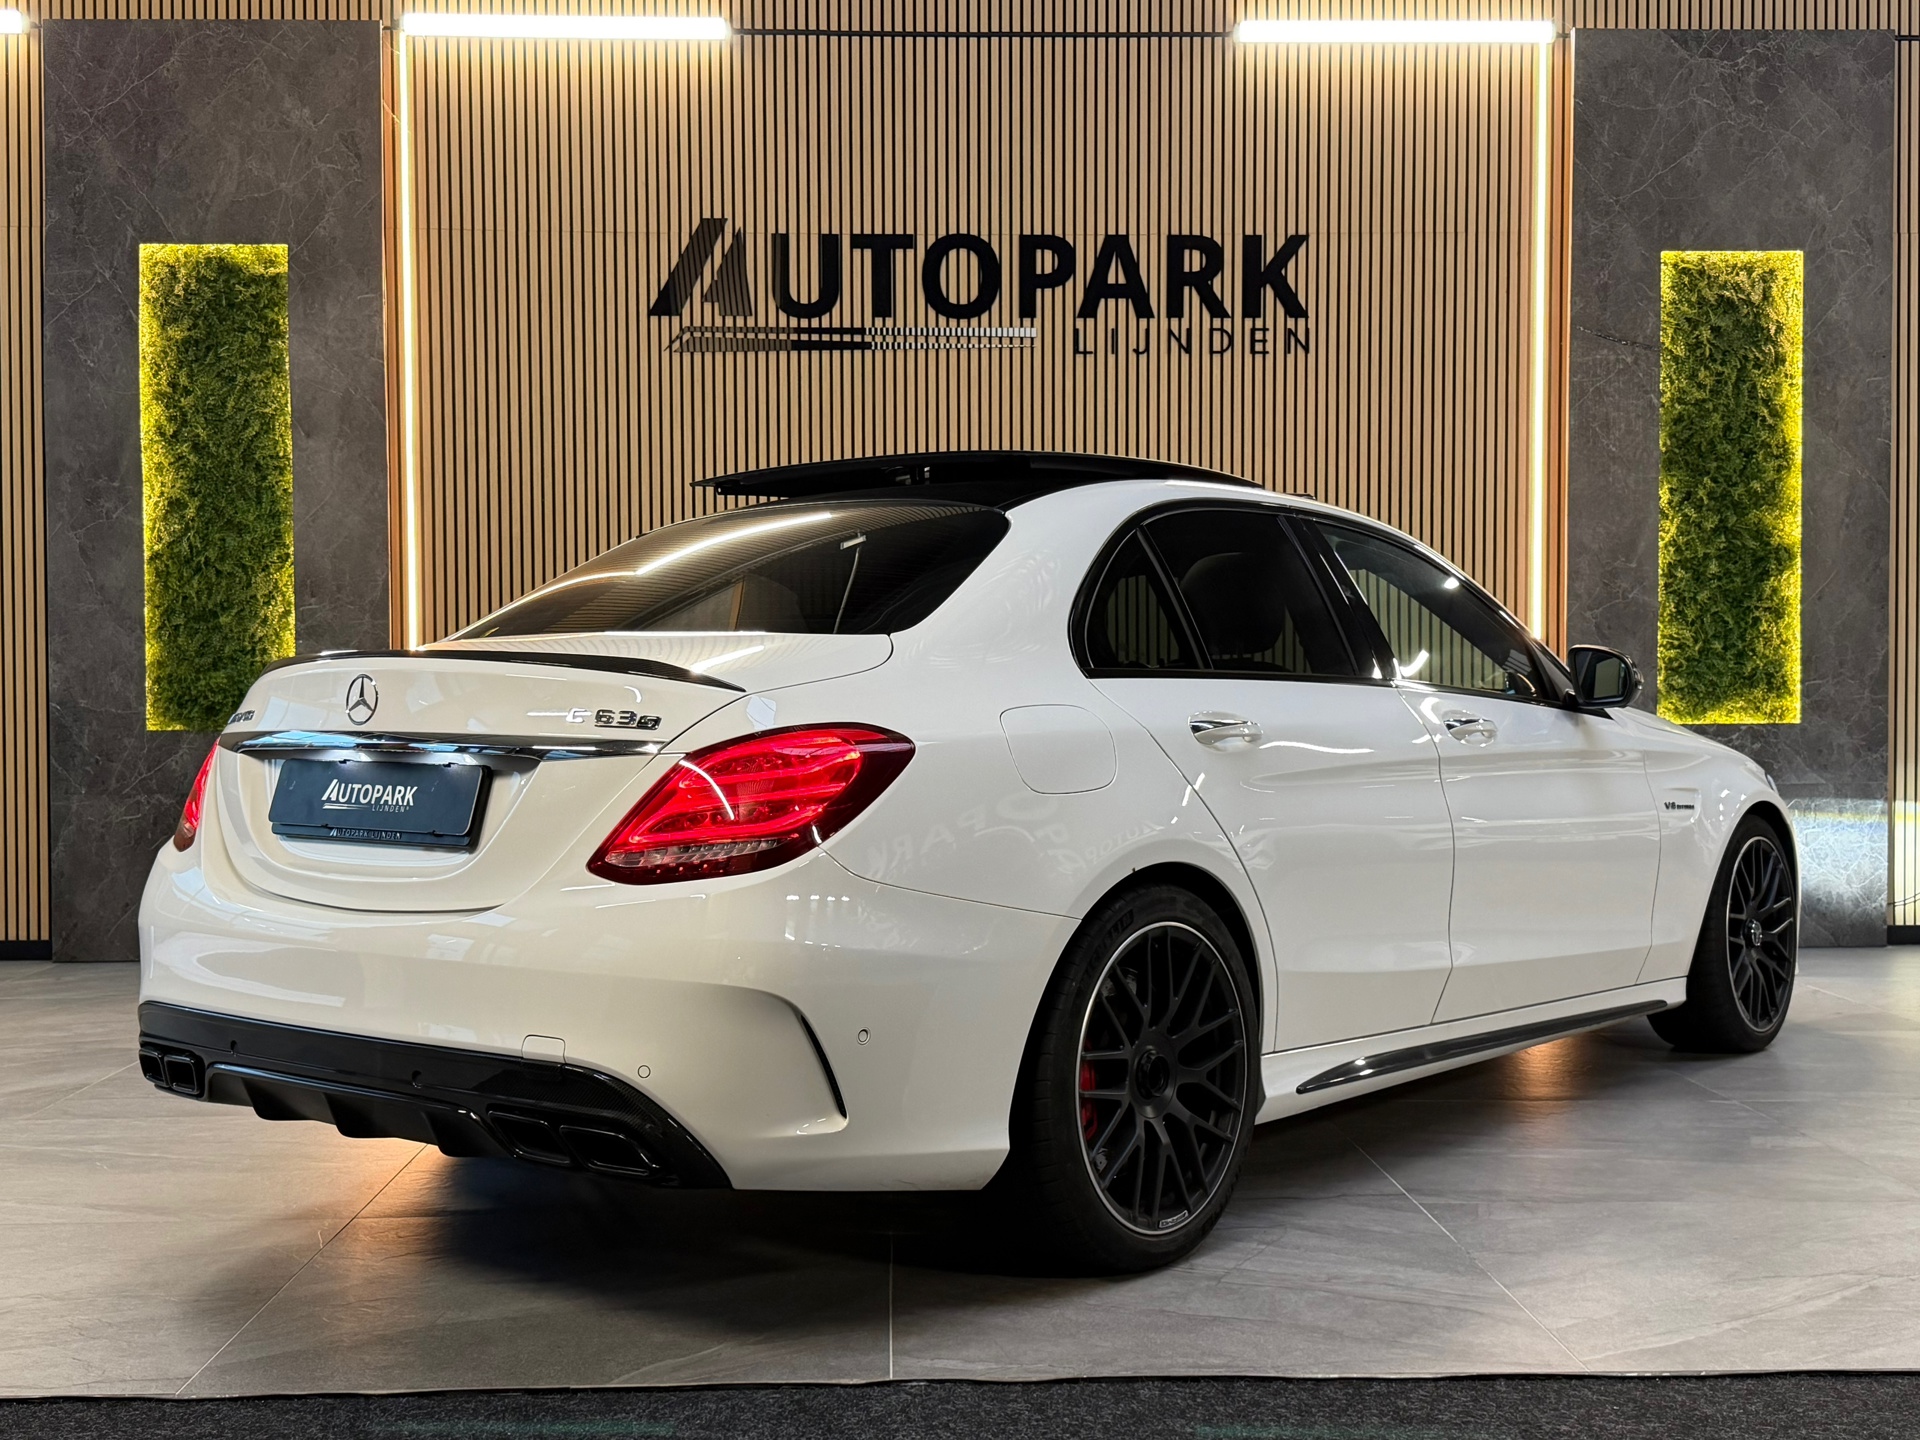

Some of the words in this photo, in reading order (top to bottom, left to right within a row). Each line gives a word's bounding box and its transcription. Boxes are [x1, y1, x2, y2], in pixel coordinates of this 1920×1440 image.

[648, 217, 1309, 319] AUTOPARK
[1074, 327, 1311, 355] LIJNDEN
[321, 779, 418, 806] AUTOPARK
